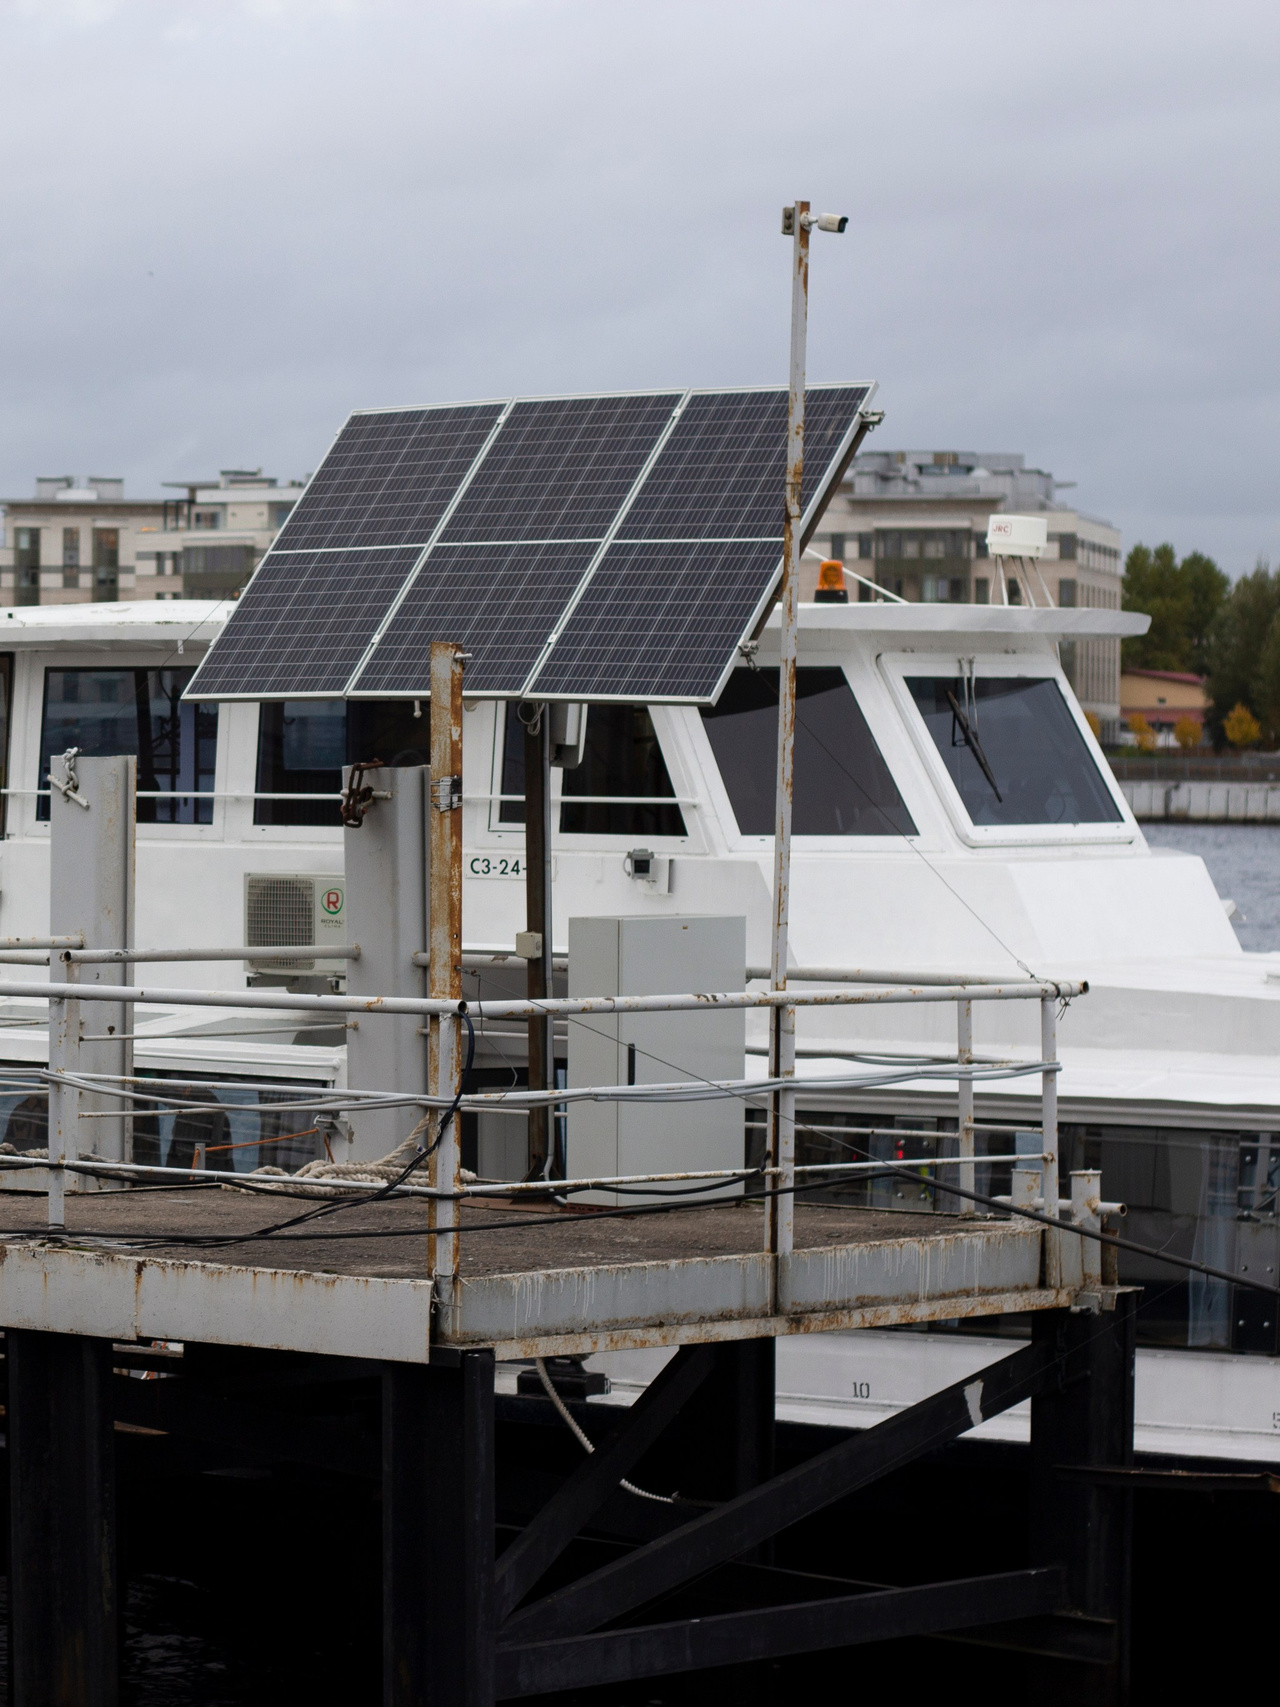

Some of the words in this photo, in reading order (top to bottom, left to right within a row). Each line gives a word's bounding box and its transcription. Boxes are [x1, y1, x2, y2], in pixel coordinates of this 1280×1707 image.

[993, 525, 1009, 533] JRC
[326, 891, 340, 910] R
[852, 1381, 870, 1399] 10
